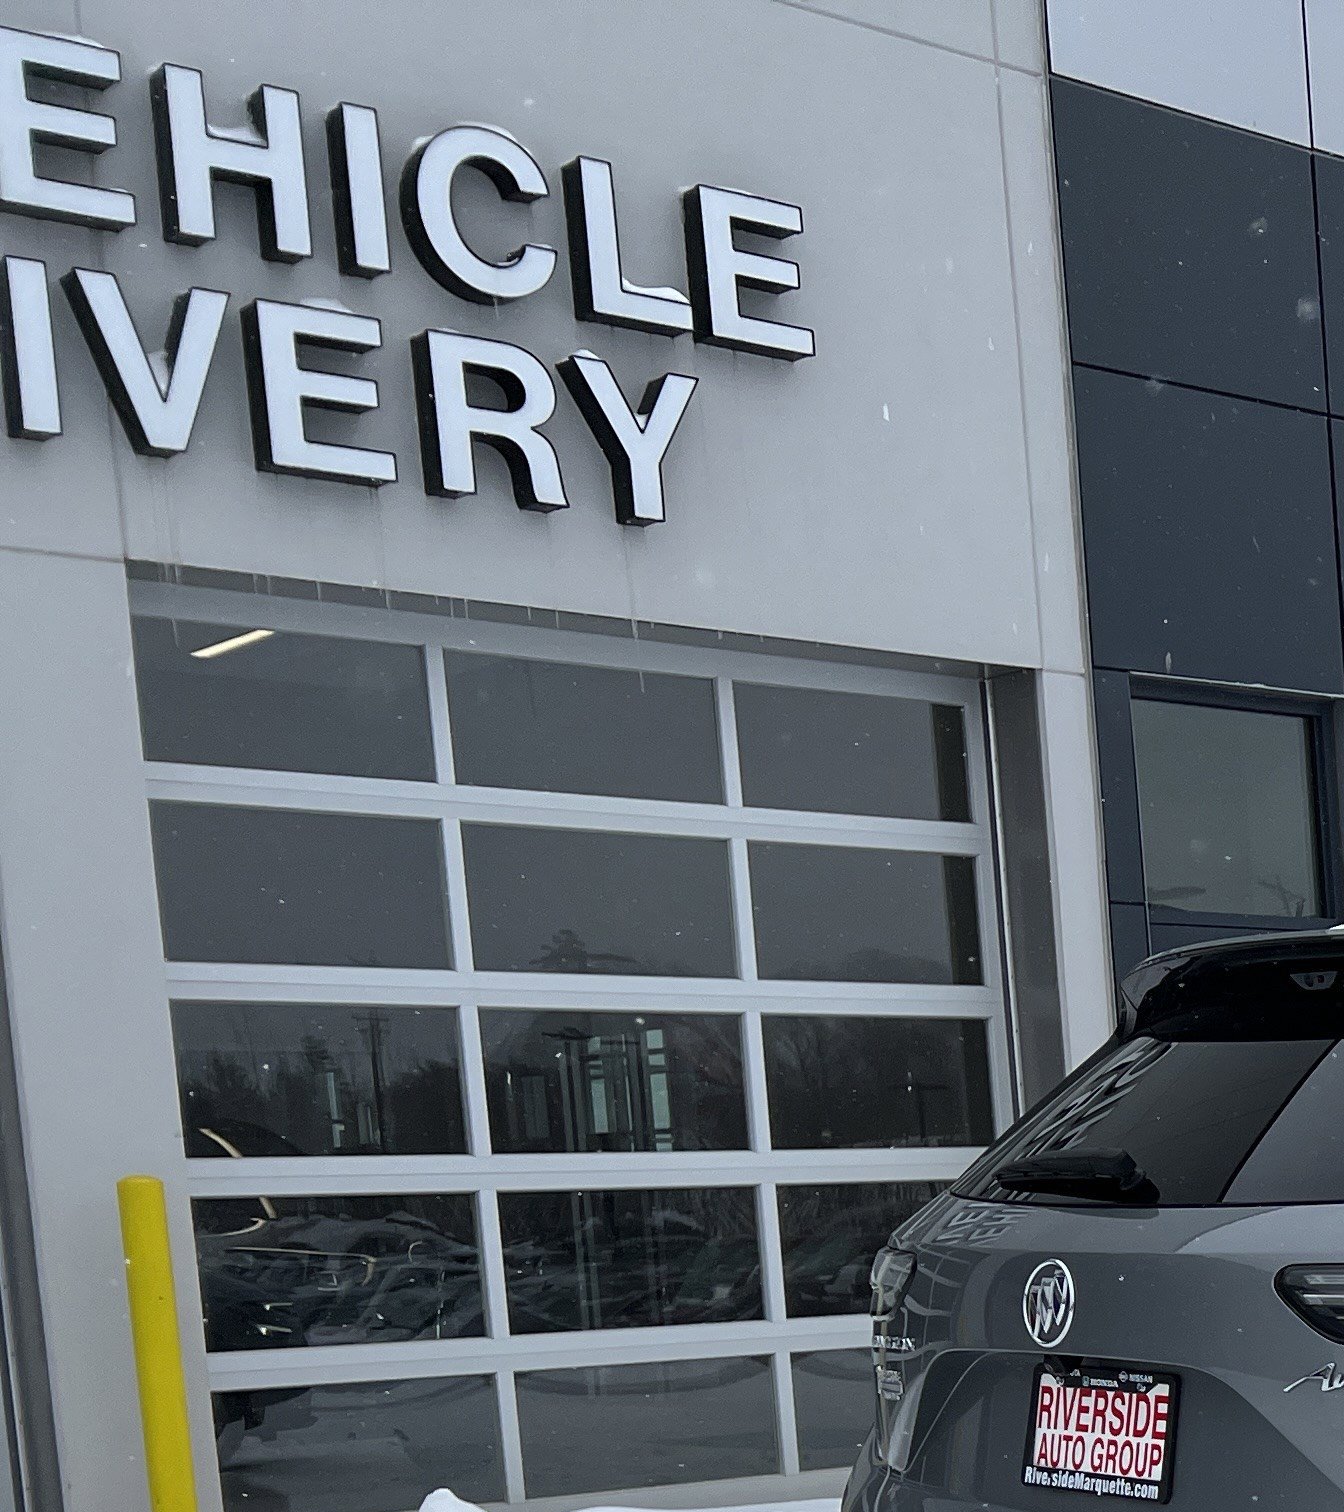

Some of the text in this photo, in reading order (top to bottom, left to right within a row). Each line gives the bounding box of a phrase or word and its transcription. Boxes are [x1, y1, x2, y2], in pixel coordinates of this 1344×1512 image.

[1038, 1385, 1170, 1440] RIVERSIDE
[1037, 1433, 1162, 1478] AUTO GROUP
